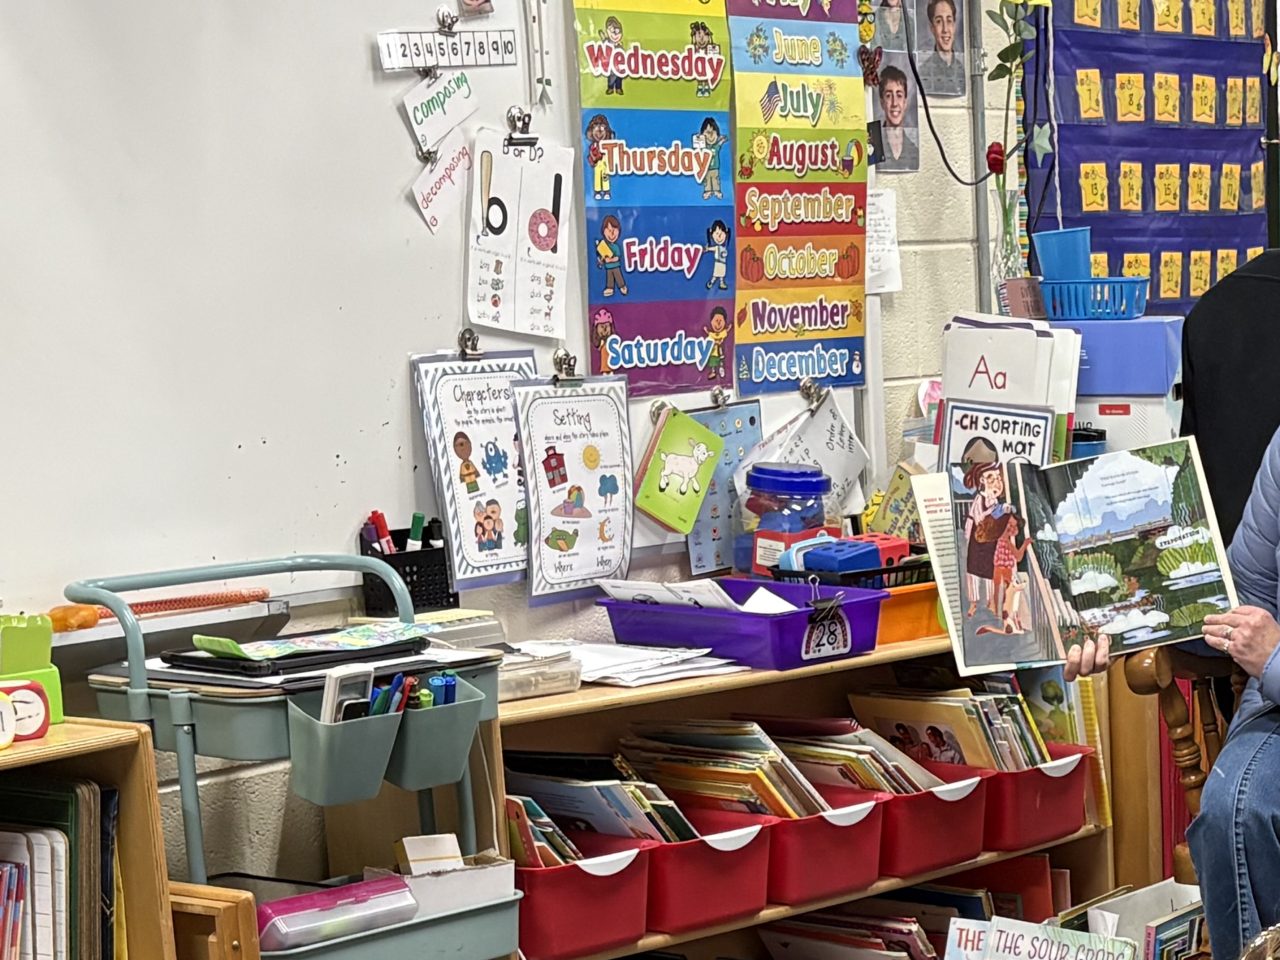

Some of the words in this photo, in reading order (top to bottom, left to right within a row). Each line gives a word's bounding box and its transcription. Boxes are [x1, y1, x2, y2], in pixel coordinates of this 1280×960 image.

[400, 43, 408, 58] 2
[412, 43, 421, 57] 3
[425, 42, 433, 57] 4
[438, 42, 446, 56] 5
[451, 42, 459, 56] 6
[465, 42, 471, 56] 7
[478, 42, 486, 56] 8
[492, 42, 499, 56] 9
[503, 41, 514, 55] 10
[586, 44, 722, 85] Wednesday
[773, 29, 820, 65] June
[780, 83, 822, 124] July
[602, 142, 711, 180] Thursday
[768, 135, 838, 174] August
[421, 146, 472, 209] decomposing
[748, 190, 853, 228] September
[626, 239, 701, 276] Friday
[765, 244, 836, 279] October
[753, 297, 847, 332] November
[608, 332, 713, 368] Saturday
[754, 346, 847, 381] December
[968, 354, 1007, 389] Aa
[553, 408, 592, 432] Setting
[816, 622, 838, 647] 28
[956, 928, 986, 952] THE
[995, 930, 1023, 954] THE
